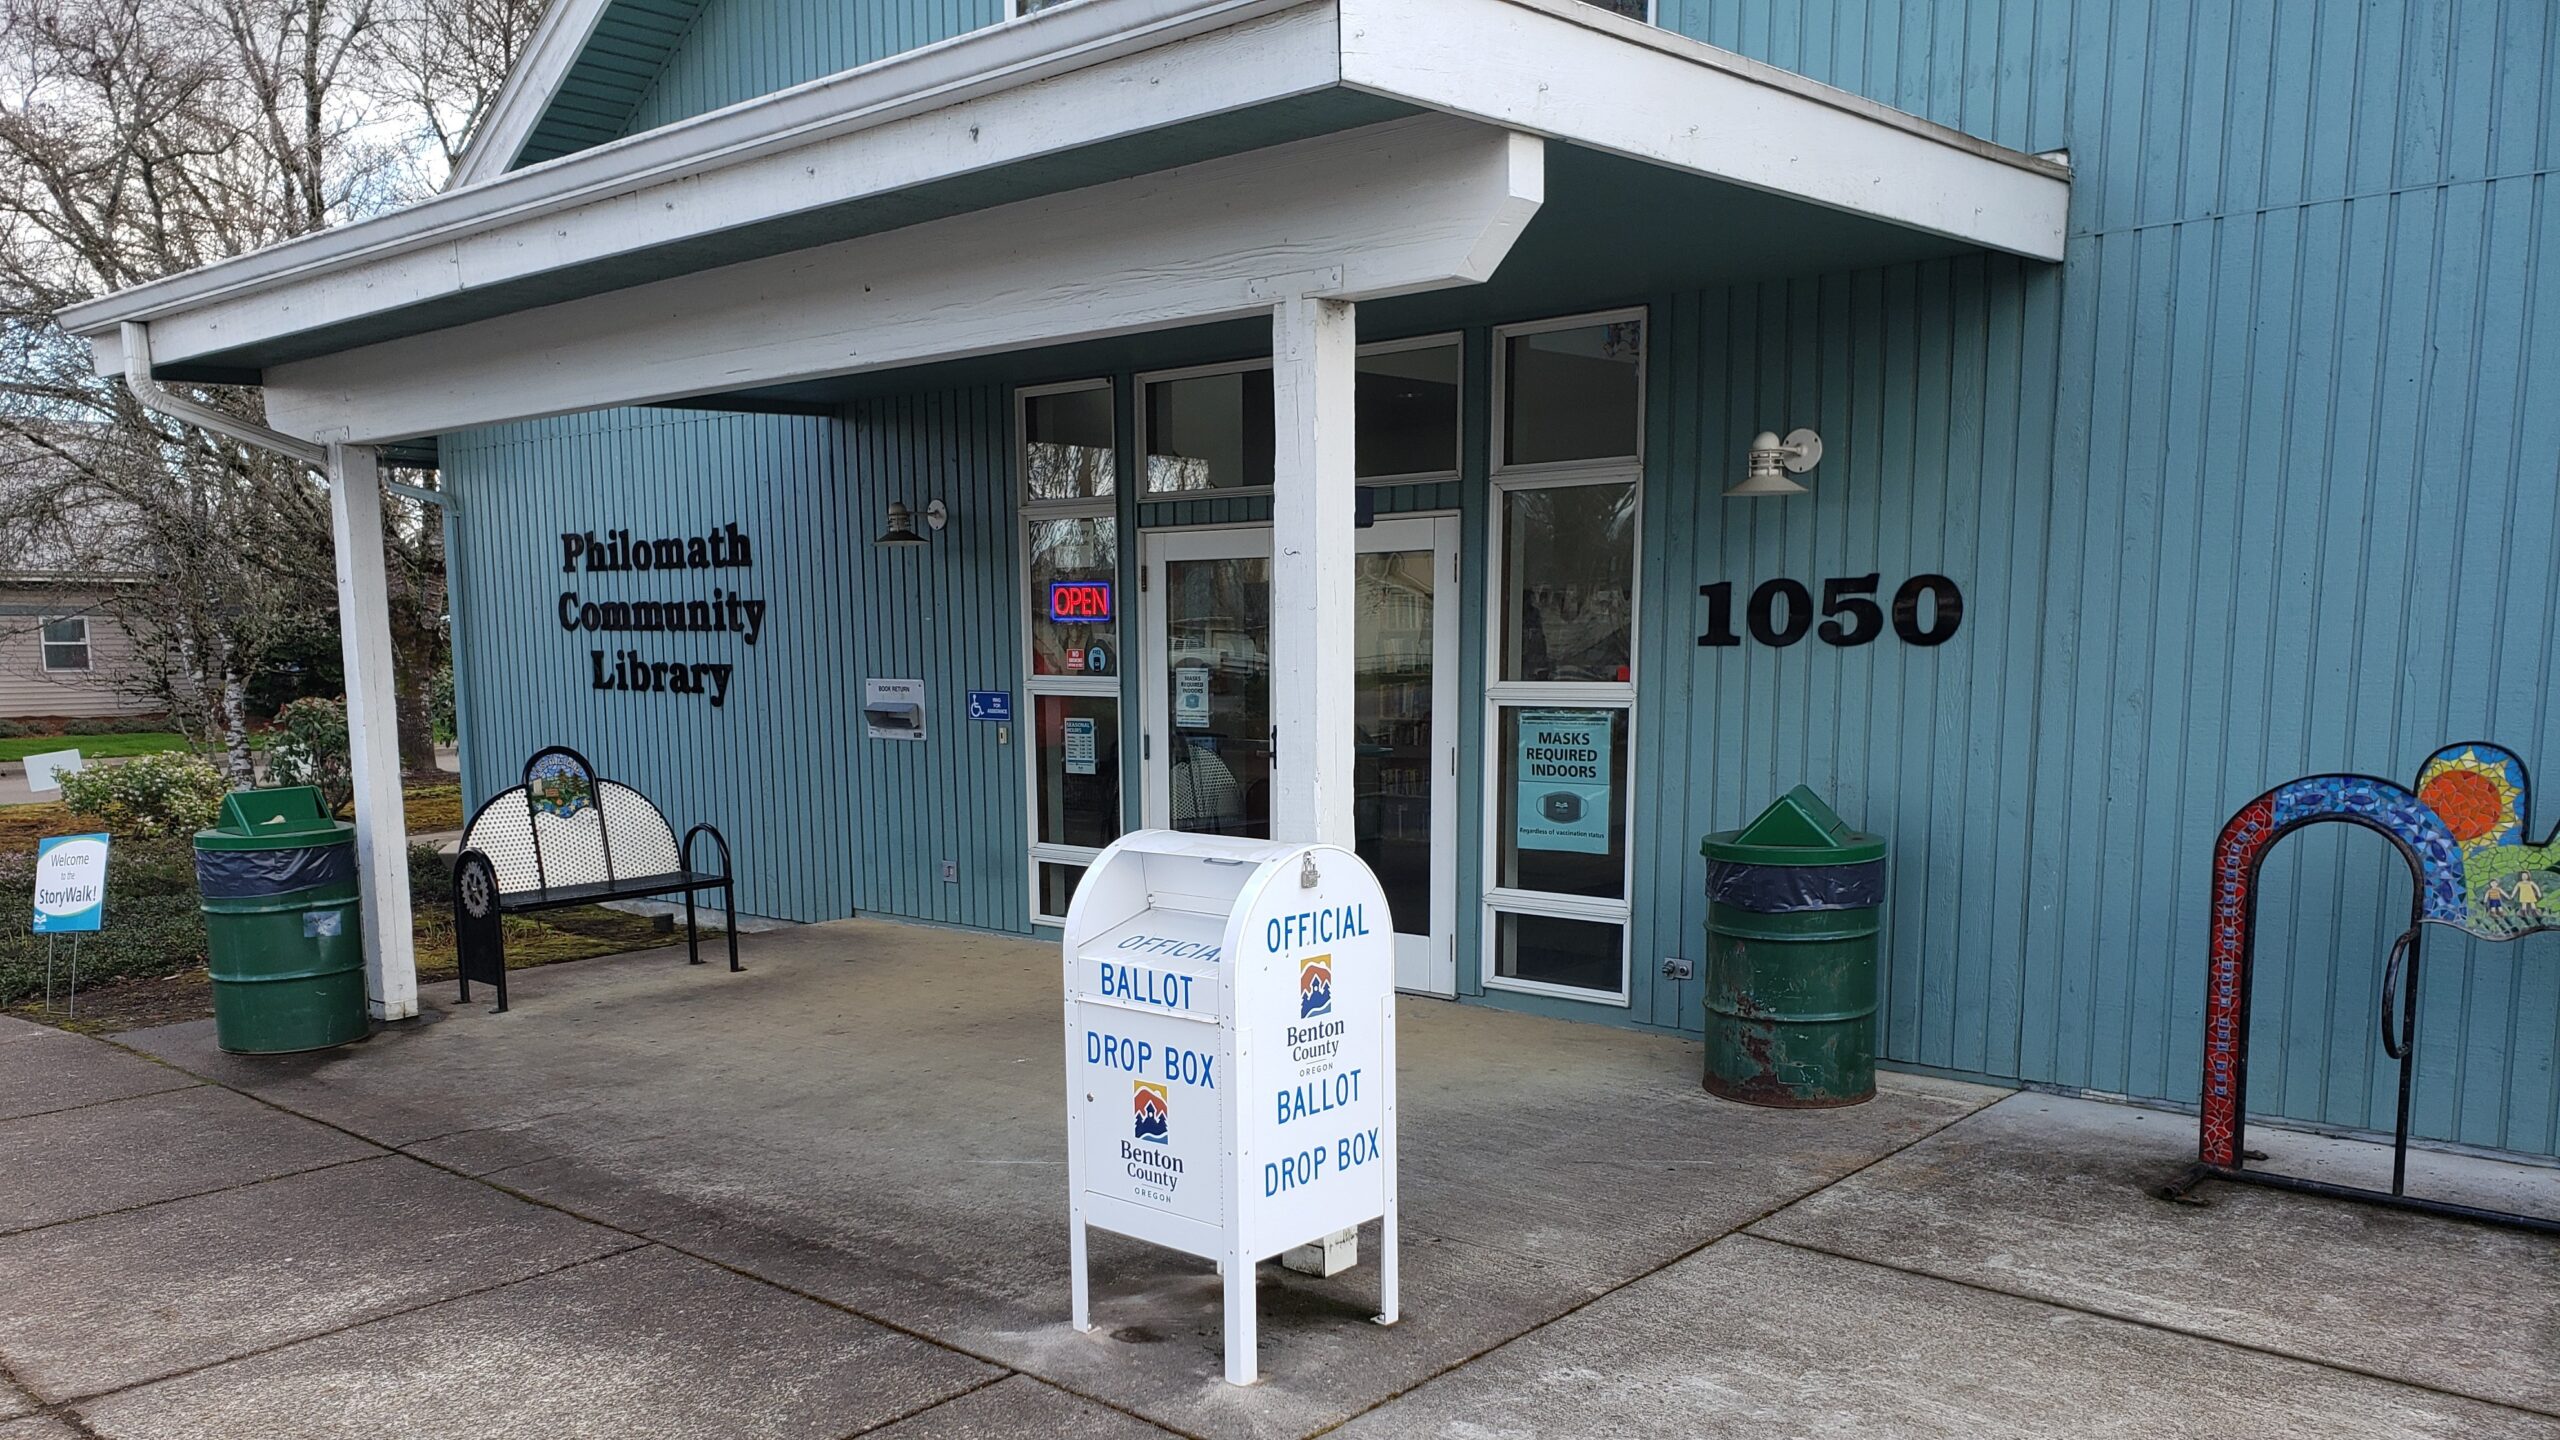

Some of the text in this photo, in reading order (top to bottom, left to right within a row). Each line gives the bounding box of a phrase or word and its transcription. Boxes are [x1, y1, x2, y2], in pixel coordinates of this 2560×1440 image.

[561, 522, 752, 573] Philomath
[558, 587, 766, 645] Community
[1054, 587, 1107, 616] OPEN
[1698, 573, 1963, 647] 1050
[591, 650, 733, 707] Library
[1538, 732, 1590, 746] MASKS
[1526, 748, 1598, 762] REQUIRED
[1531, 764, 1597, 778] INDOORS
[1520, 827, 1547, 835] Regardless
[1556, 829, 1588, 837] vaccination
[51, 853, 90, 867] Welcome
[67, 872, 75, 880] the
[39, 885, 97, 908] StoryWalk!
[1267, 903, 1370, 953] OFFICIAL
[2223, 927, 2235, 949] OF
[1118, 936, 1221, 963] OFFICIA
[1101, 962, 1193, 1010] BALLOT
[2220, 961, 2232, 1007] LOVE
[1287, 1019, 1345, 1047] Benton
[2217, 1018, 2230, 1051] THE
[1087, 1030, 1215, 1090] DROP BOX
[1292, 1038, 1340, 1063] County
[1299, 1062, 1333, 1078] OREGON
[1277, 1068, 1361, 1125] BALLOT
[1121, 1139, 1184, 1174] Benton
[1265, 1127, 1380, 1198] DROP BOX
[1127, 1162, 1178, 1192] County
[1134, 1187, 1172, 1203] OREGON
